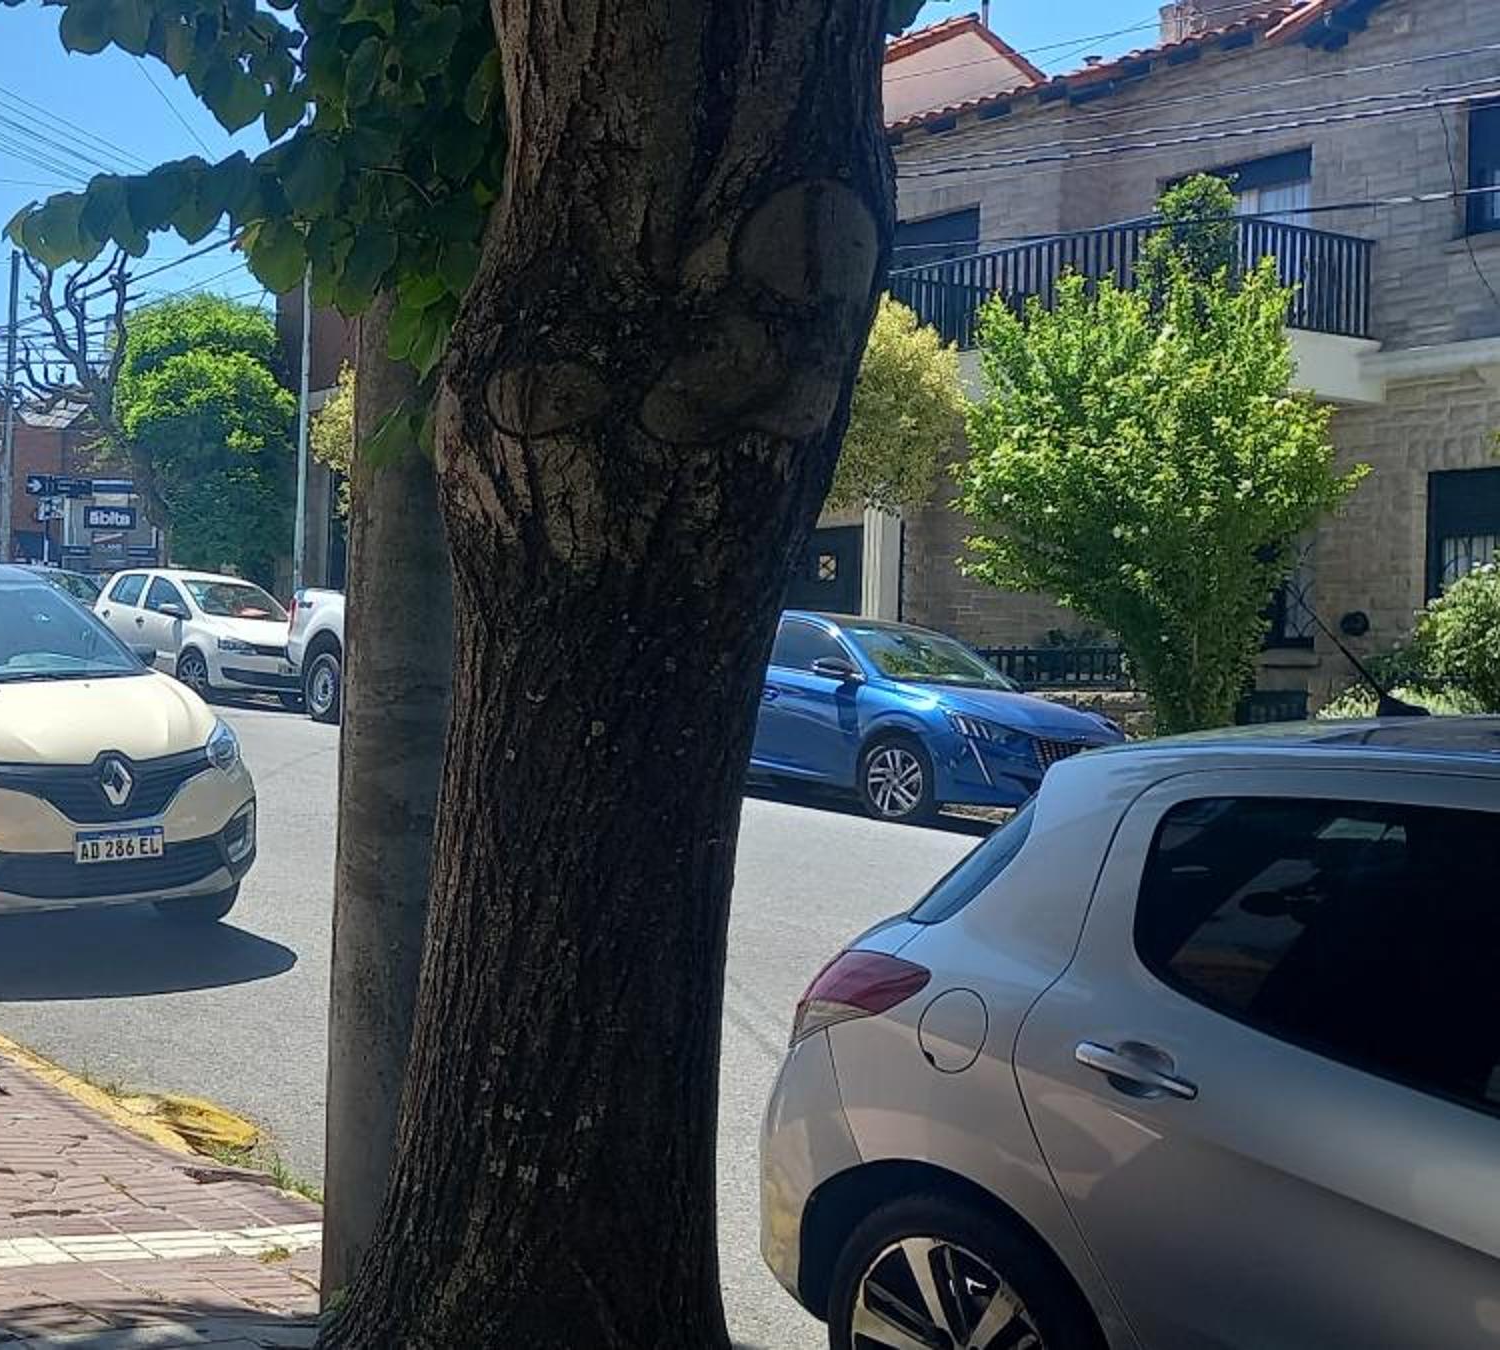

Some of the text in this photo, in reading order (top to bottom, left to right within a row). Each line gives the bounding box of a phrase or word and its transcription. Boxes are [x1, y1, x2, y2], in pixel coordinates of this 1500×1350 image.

[81, 837, 159, 860] AD 286 EL
